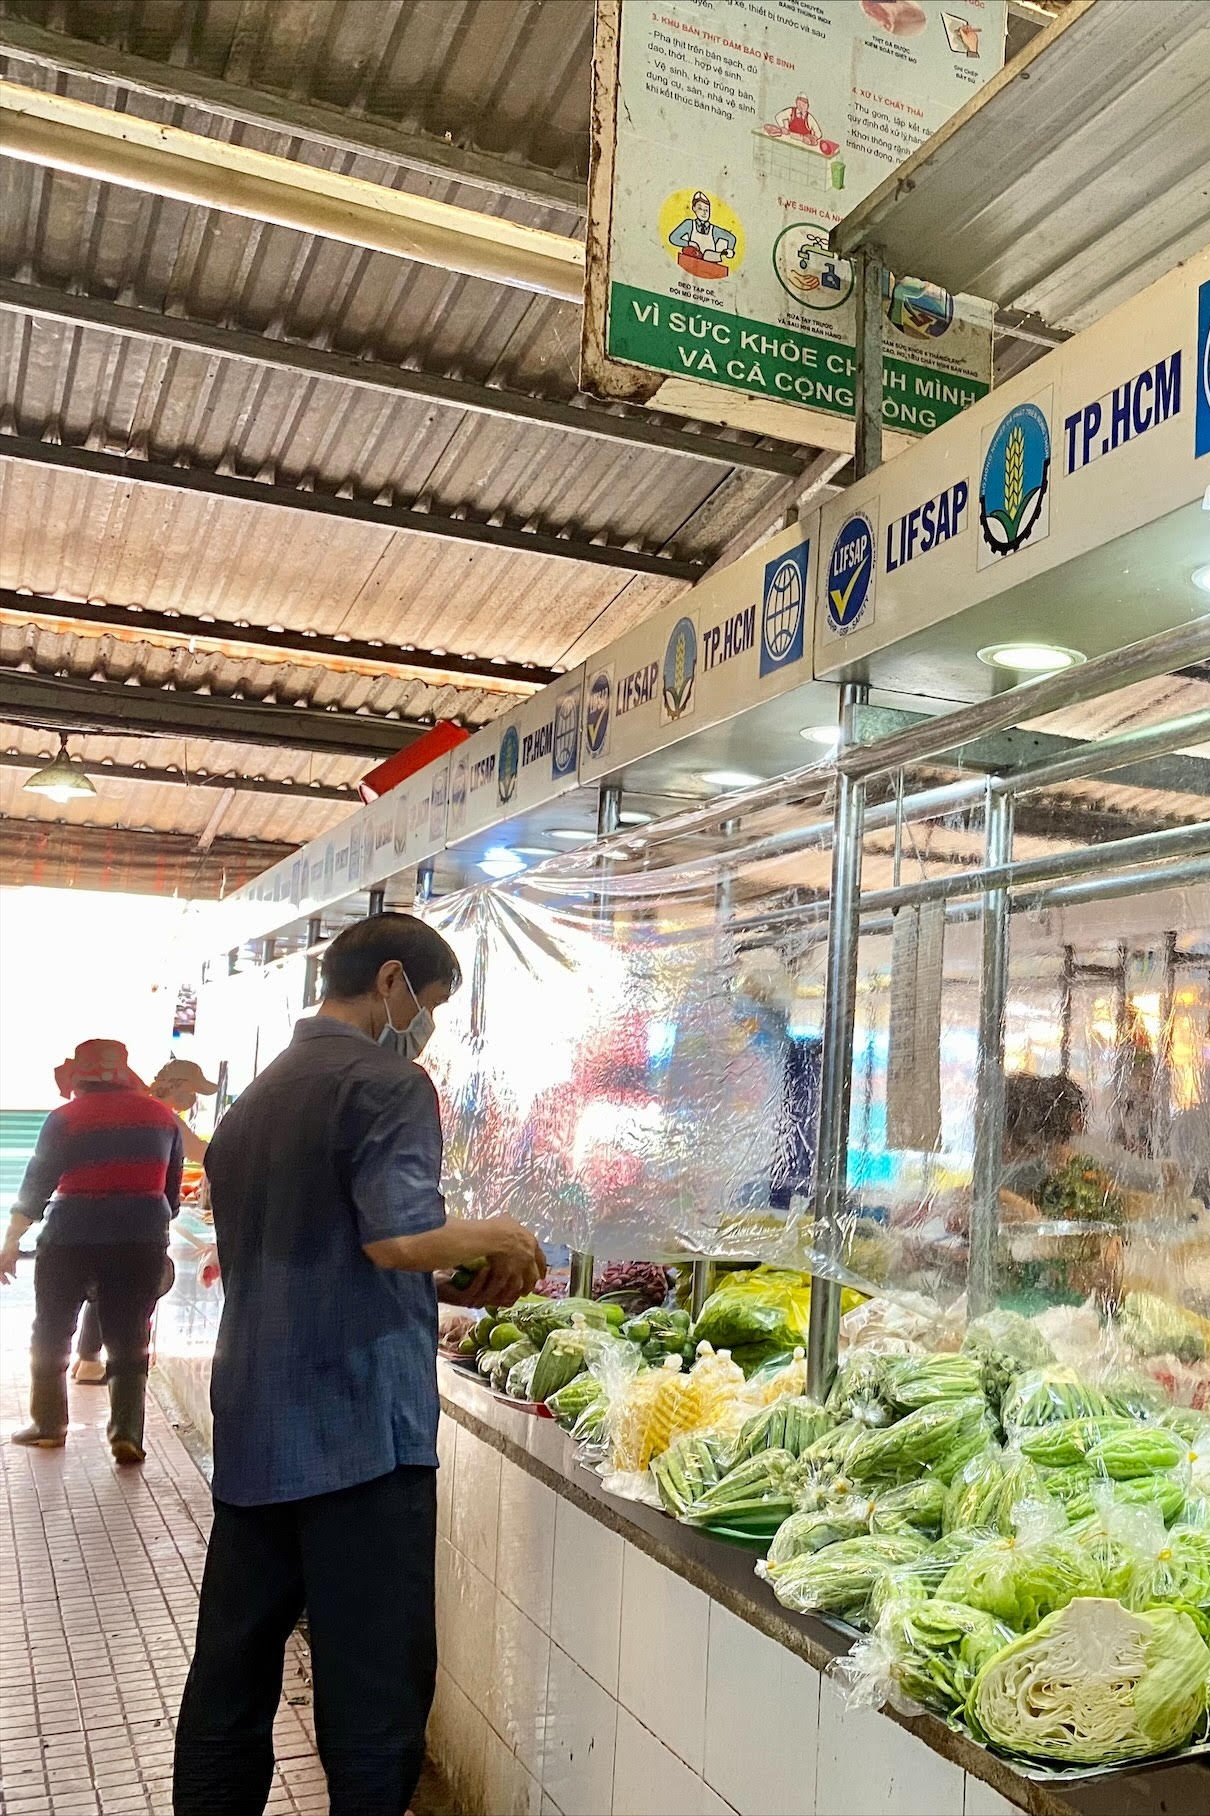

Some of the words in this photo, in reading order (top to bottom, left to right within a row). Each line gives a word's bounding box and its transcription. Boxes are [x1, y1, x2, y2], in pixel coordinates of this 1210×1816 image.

[653, 30, 671, 44] Pha
[687, 43, 704, 56] trên
[661, 16, 680, 29] KHU
[776, 58, 795, 70] SINH
[800, 24, 810, 33] và
[811, 29, 826, 39] sau
[648, 42, 667, 56] dao,
[694, 57, 712, 71] hợp
[713, 65, 723, 75] vệ
[654, 60, 666, 71] Vệ
[669, 66, 690, 80] sinh,
[646, 82, 659, 94] khi
[726, 98, 736, 108] vệ
[738, 103, 756, 114] sinh
[854, 102, 869, 114] Thu
[871, 110, 891, 123] gom,
[871, 136, 893, 151] thông
[798, 203, 817, 215] SINH
[800, 316, 812, 324] TAY
[632, 301, 660, 327] VÌ
[668, 312, 731, 345] SỨC
[740, 330, 818, 369] KHỎE
[915, 378, 976, 407] MÌNH
[678, 346, 718, 375] VÀ
[726, 360, 767, 387] CẢ
[886, 480, 968, 573] LIFSAP
[1064, 349, 1182, 475] TP.HCM
[834, 534, 867, 577] LIFSAP
[615, 660, 659, 717] LIFSAP
[703, 604, 756, 673] TP.HCM
[522, 721, 554, 768] TP.HCM
